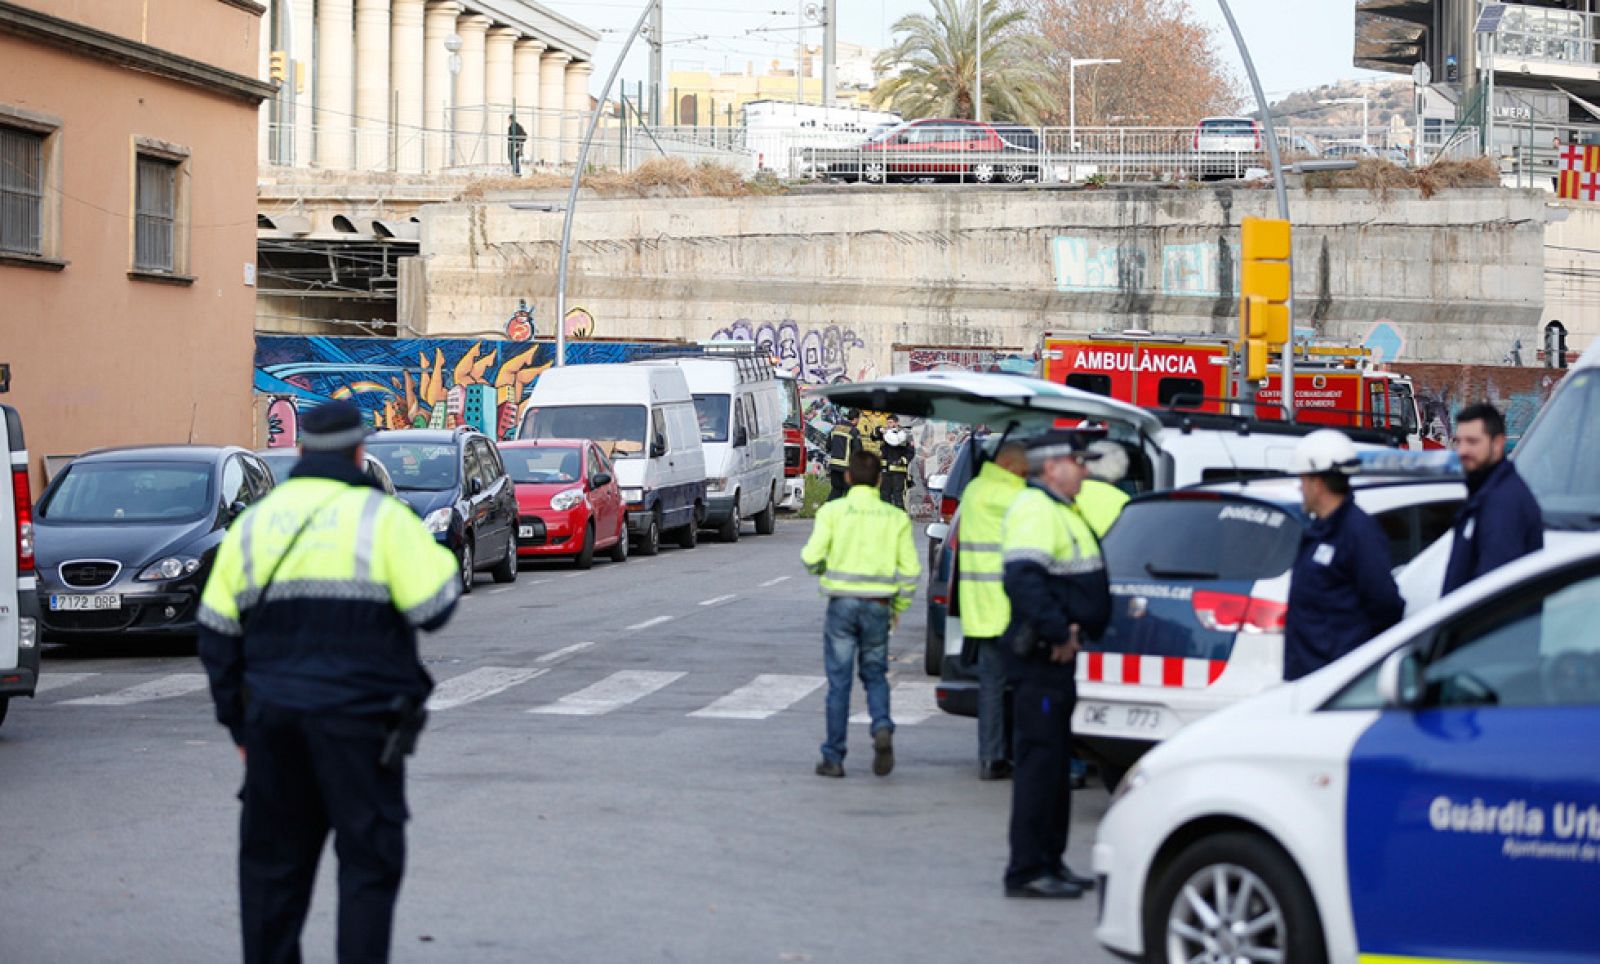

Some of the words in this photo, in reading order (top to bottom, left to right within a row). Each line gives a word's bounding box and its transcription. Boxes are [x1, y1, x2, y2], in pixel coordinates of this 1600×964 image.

[1074, 349, 1198, 374] AMBULÀNCIA
[1259, 390, 1282, 398] CENTR
[1305, 400, 1336, 408] BOMBERS
[267, 509, 338, 535] POCIA
[58, 596, 89, 609] 7172
[1429, 796, 1545, 836] Guàrdia
